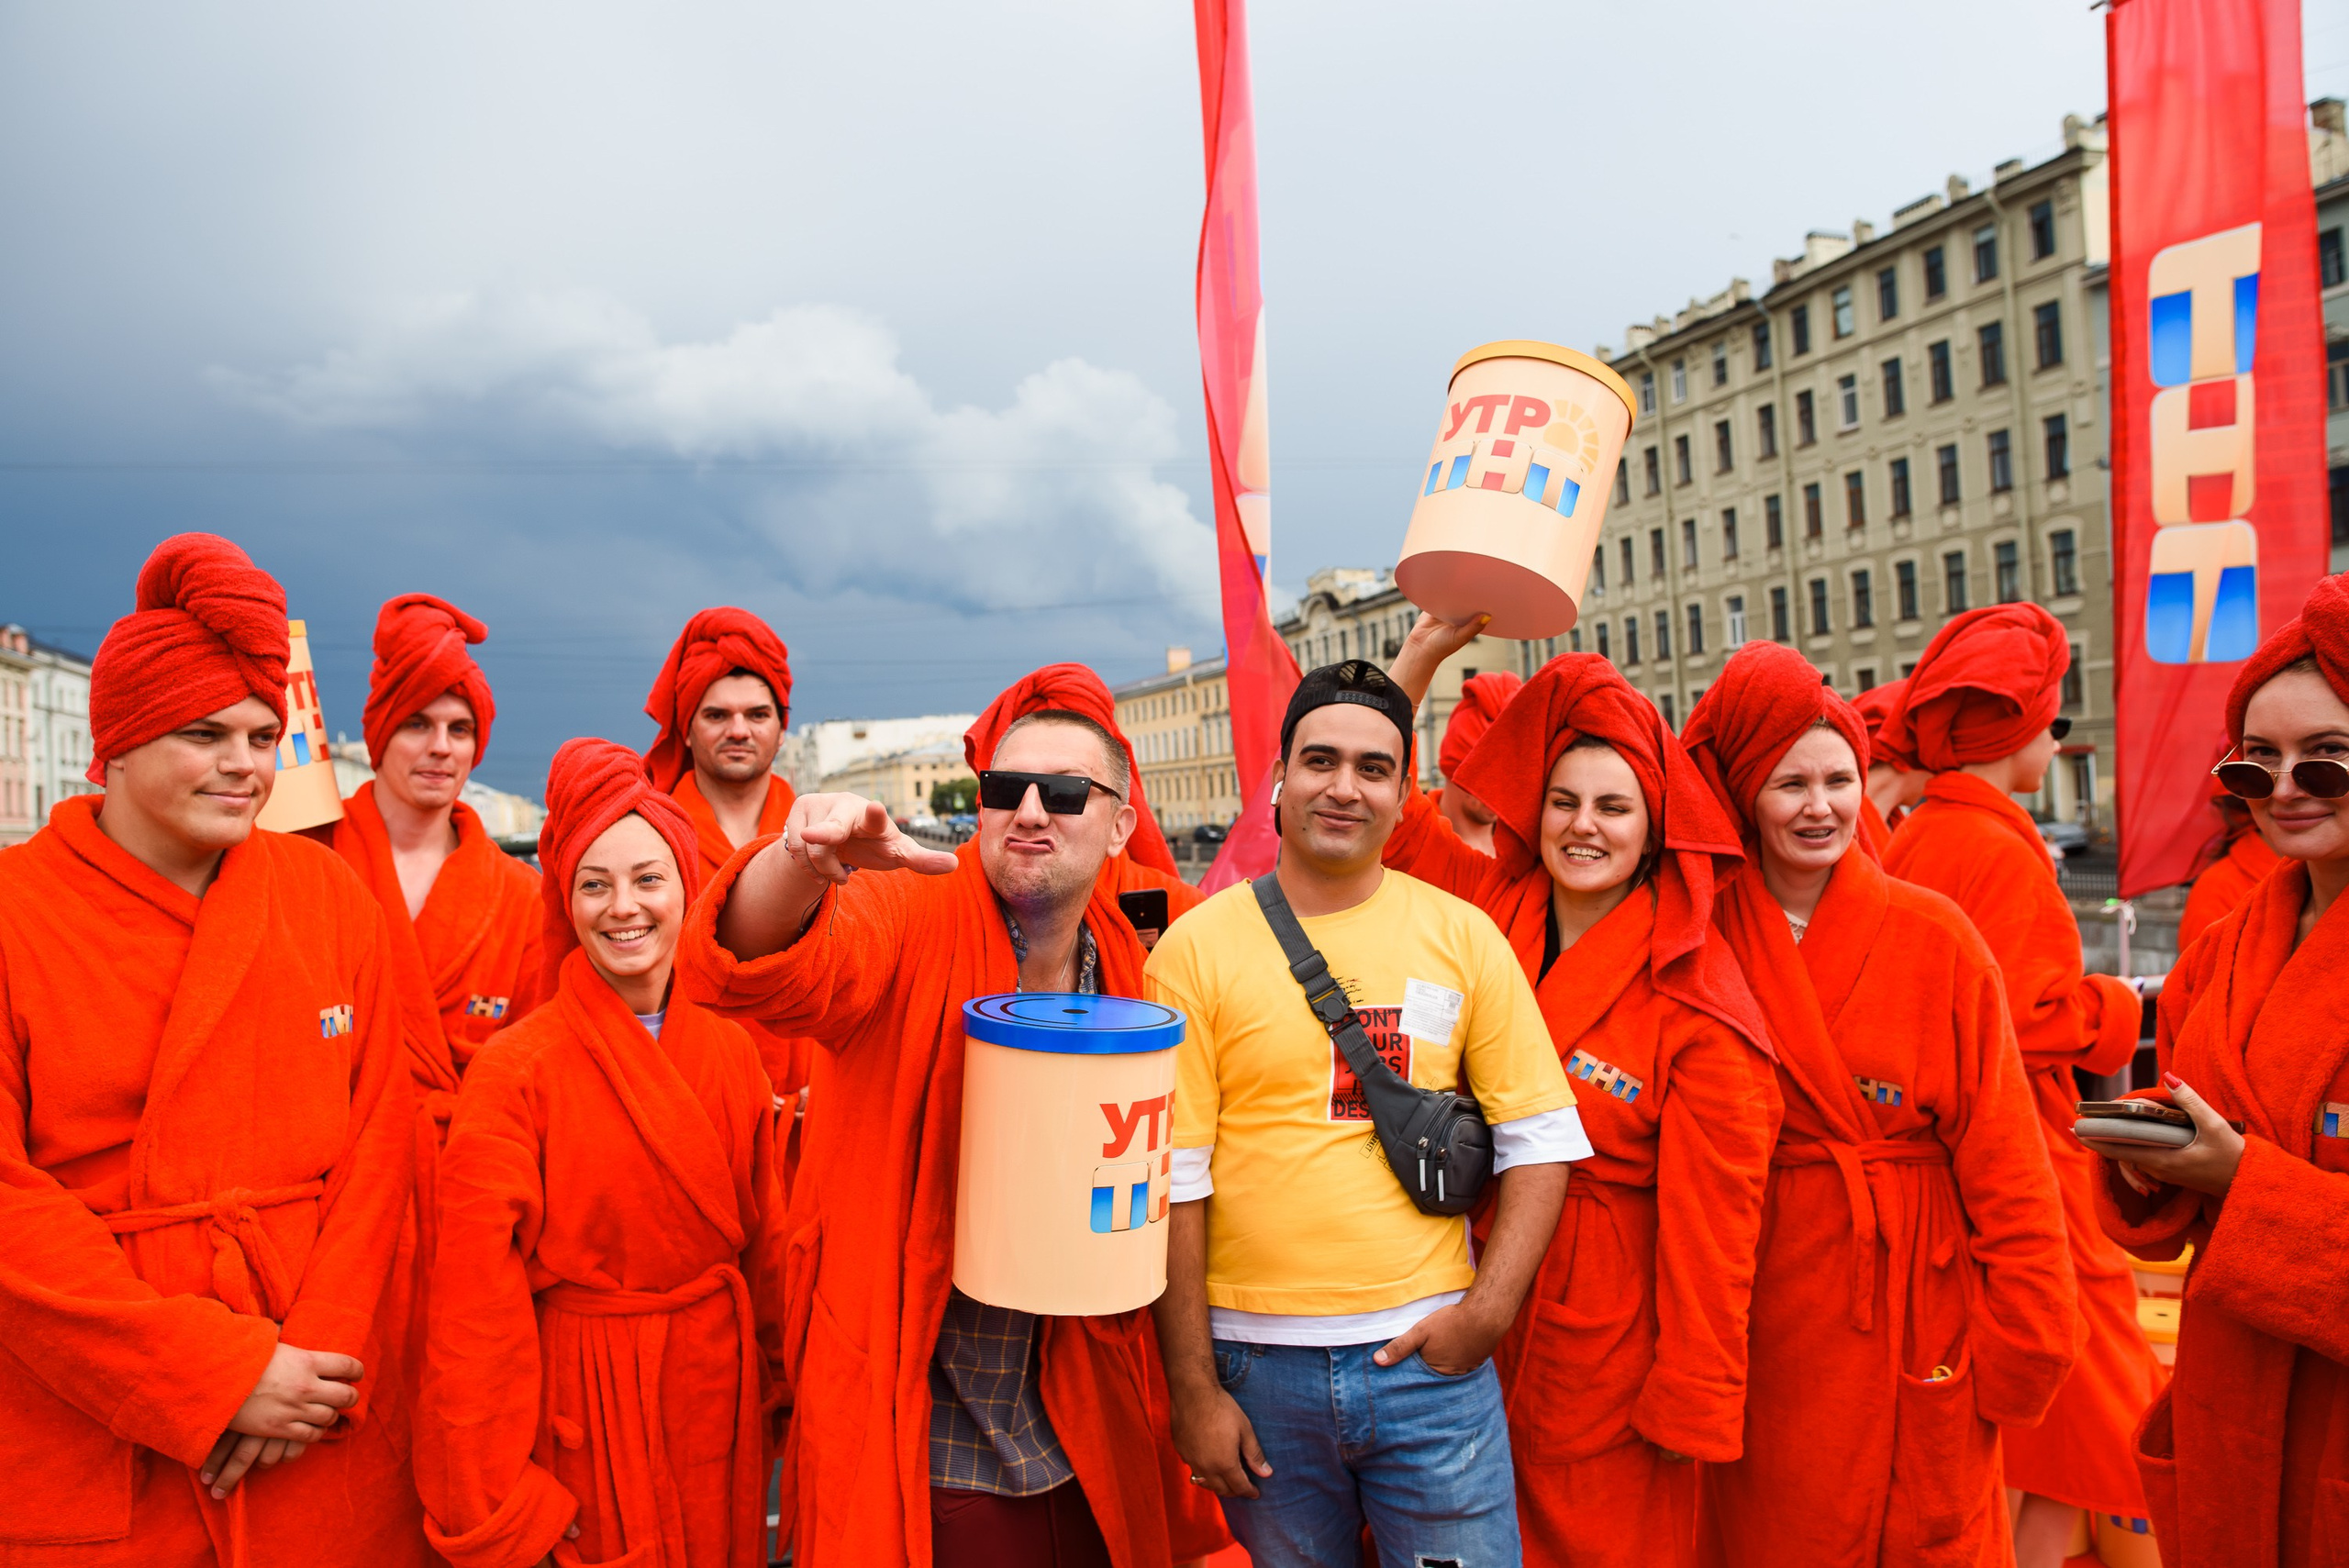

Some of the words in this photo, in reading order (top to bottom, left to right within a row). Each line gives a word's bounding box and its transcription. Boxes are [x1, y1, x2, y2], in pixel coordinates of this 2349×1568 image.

[2146, 220, 2262, 664] ТНТ
[1424, 438, 1584, 518] ТНТ
[1358, 1009, 1402, 1028] ON'T
[1368, 1033, 1403, 1051] UR
[1565, 1049, 1643, 1104] ТНТ
[1854, 1075, 1904, 1107] НТ
[1333, 1100, 1370, 1118] DES
[1365, 1133, 1379, 1152] ARKET
